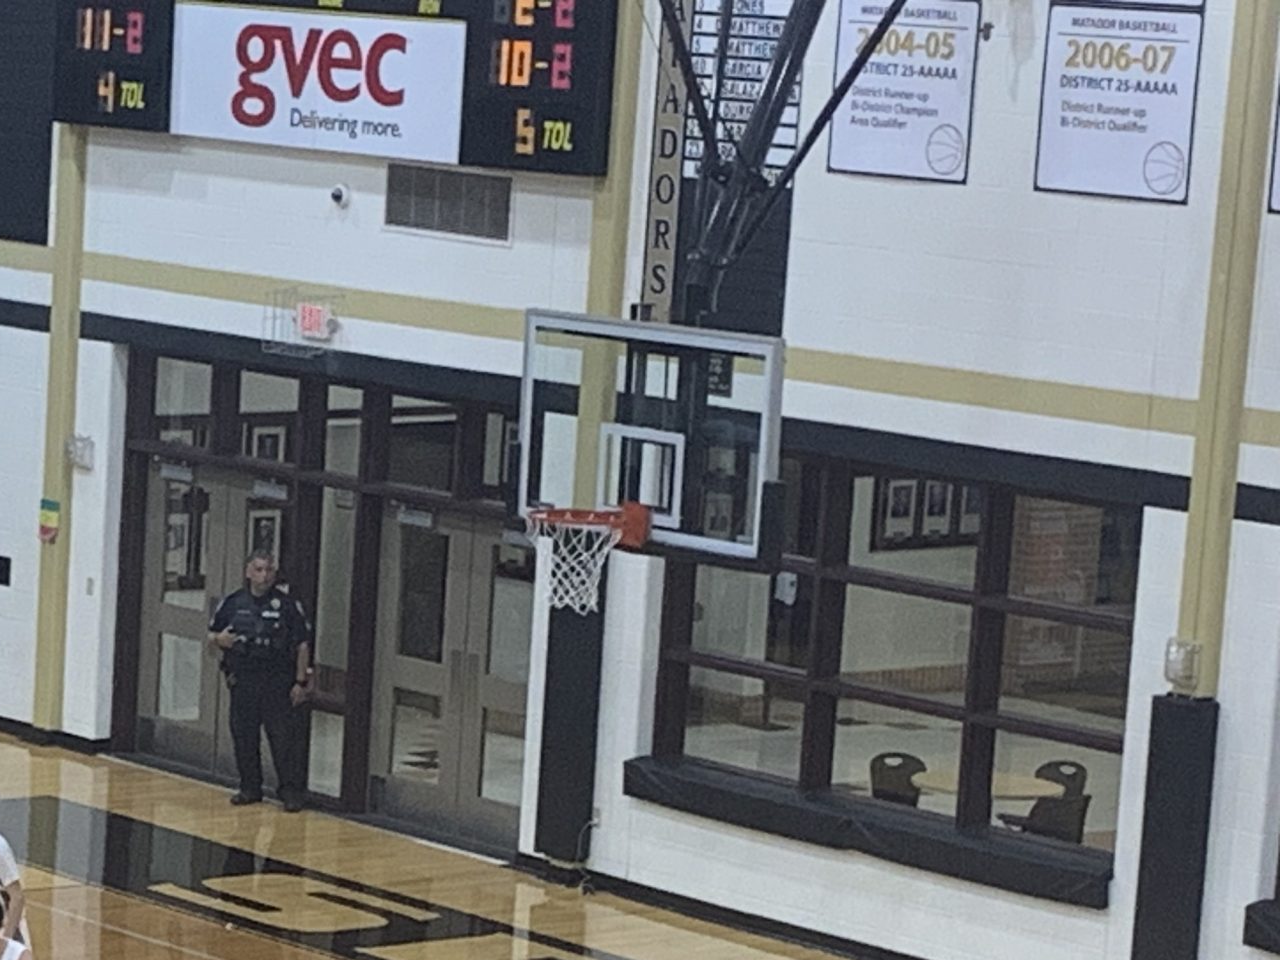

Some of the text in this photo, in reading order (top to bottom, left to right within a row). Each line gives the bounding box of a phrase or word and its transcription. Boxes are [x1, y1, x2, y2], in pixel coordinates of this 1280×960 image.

[231, 23, 407, 128] gvec
[1065, 39, 1177, 75] 2006-07
[98, 71, 145, 113] 4 TOL
[1060, 74, 1114, 91] DISTRICT
[290, 107, 358, 139] Delivering
[515, 109, 573, 155] 5 TOL
